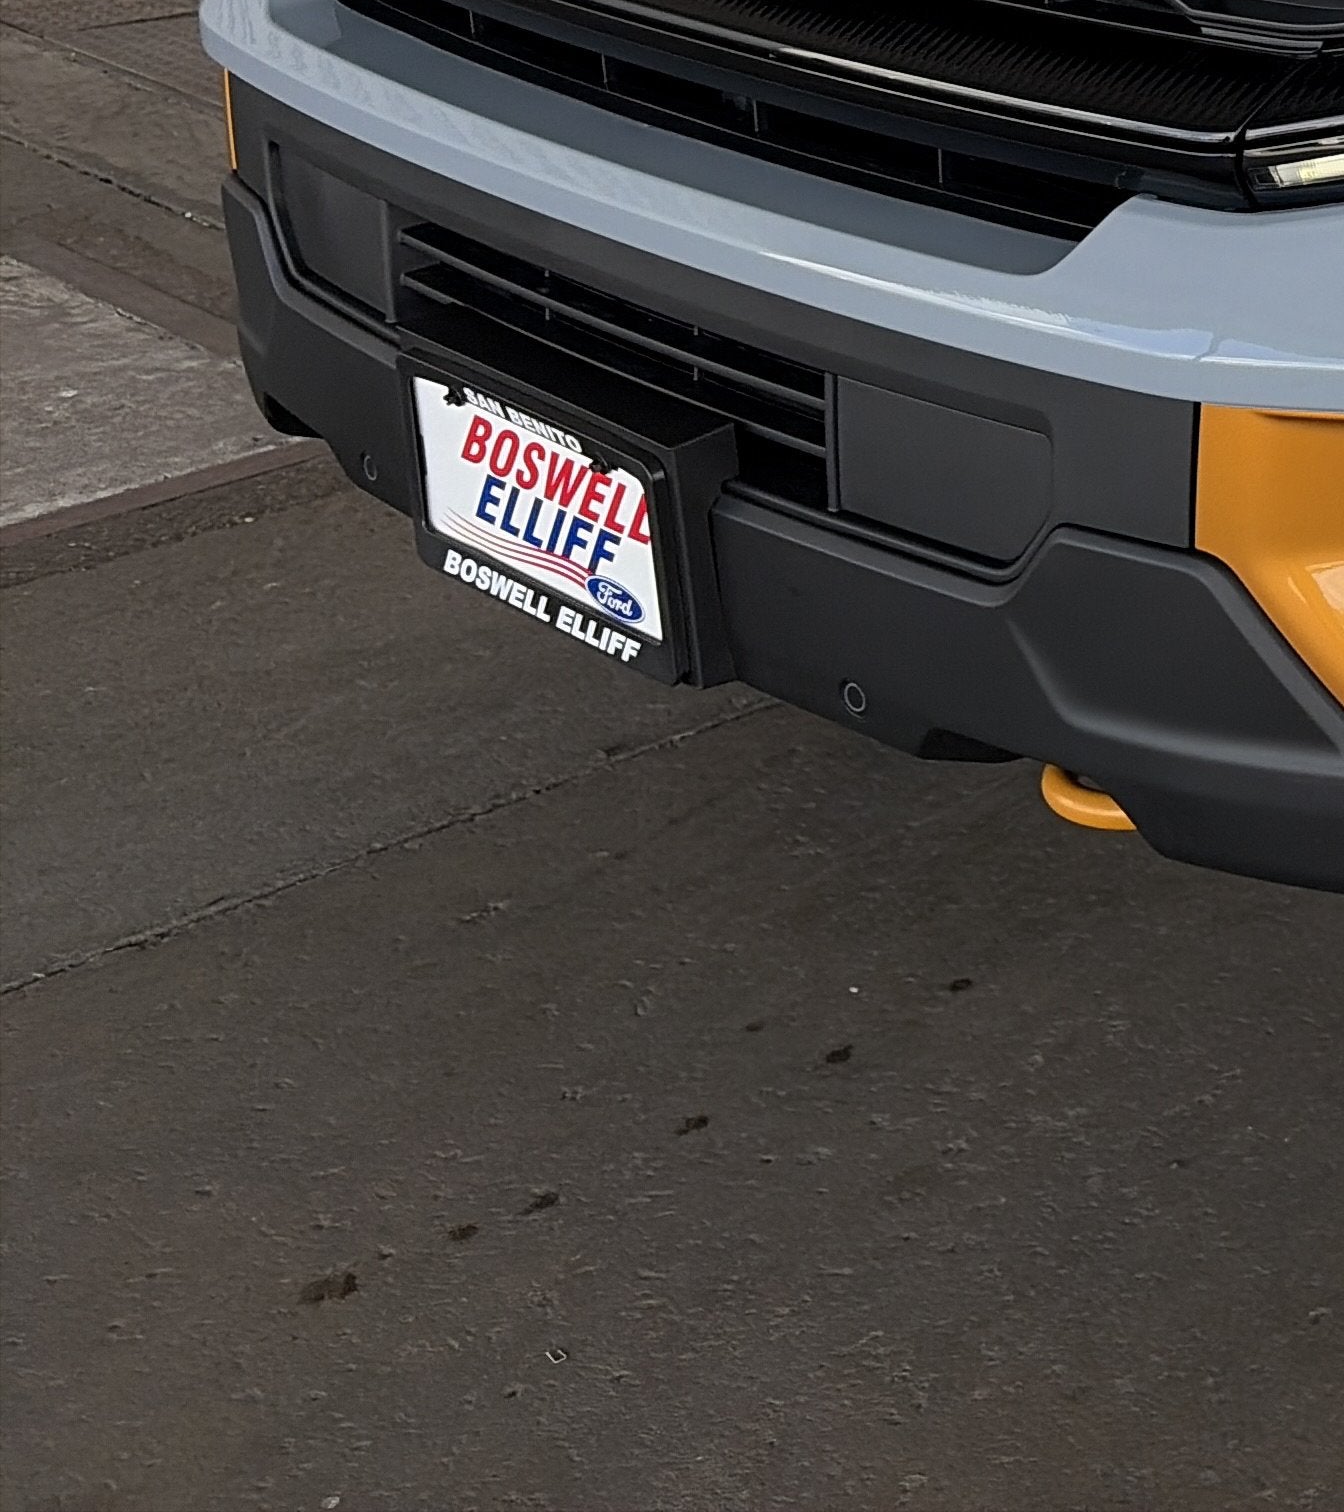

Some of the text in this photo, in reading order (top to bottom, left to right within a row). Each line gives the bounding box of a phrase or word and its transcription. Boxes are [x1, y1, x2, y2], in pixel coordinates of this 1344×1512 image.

[463, 387, 583, 453] SAN BENITO
[460, 414, 651, 546] BOSWELL
[475, 474, 622, 574] ELLIFF
[443, 549, 642, 663] BOSWELL ELLIFF
[595, 580, 634, 618] Ford
